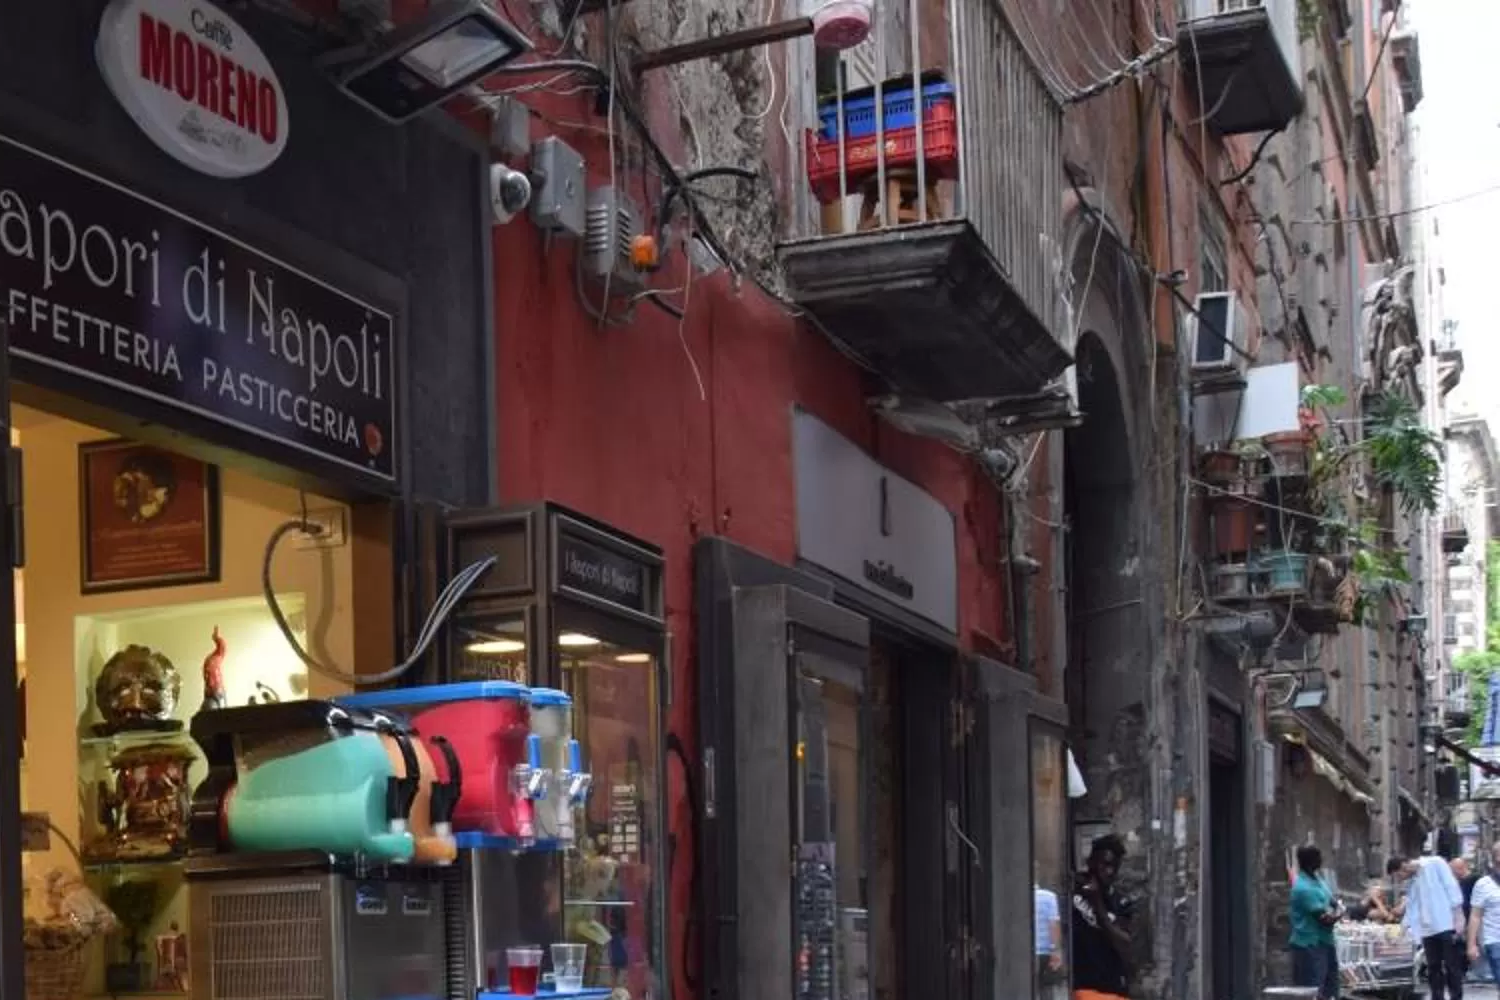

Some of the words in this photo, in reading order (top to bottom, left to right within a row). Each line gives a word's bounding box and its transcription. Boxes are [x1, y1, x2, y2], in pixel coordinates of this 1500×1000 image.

[139, 11, 278, 145] MORENO
[183, 246, 227, 335] di
[246, 268, 382, 400] Napoli
[202, 356, 361, 449] PASTICCERIA
